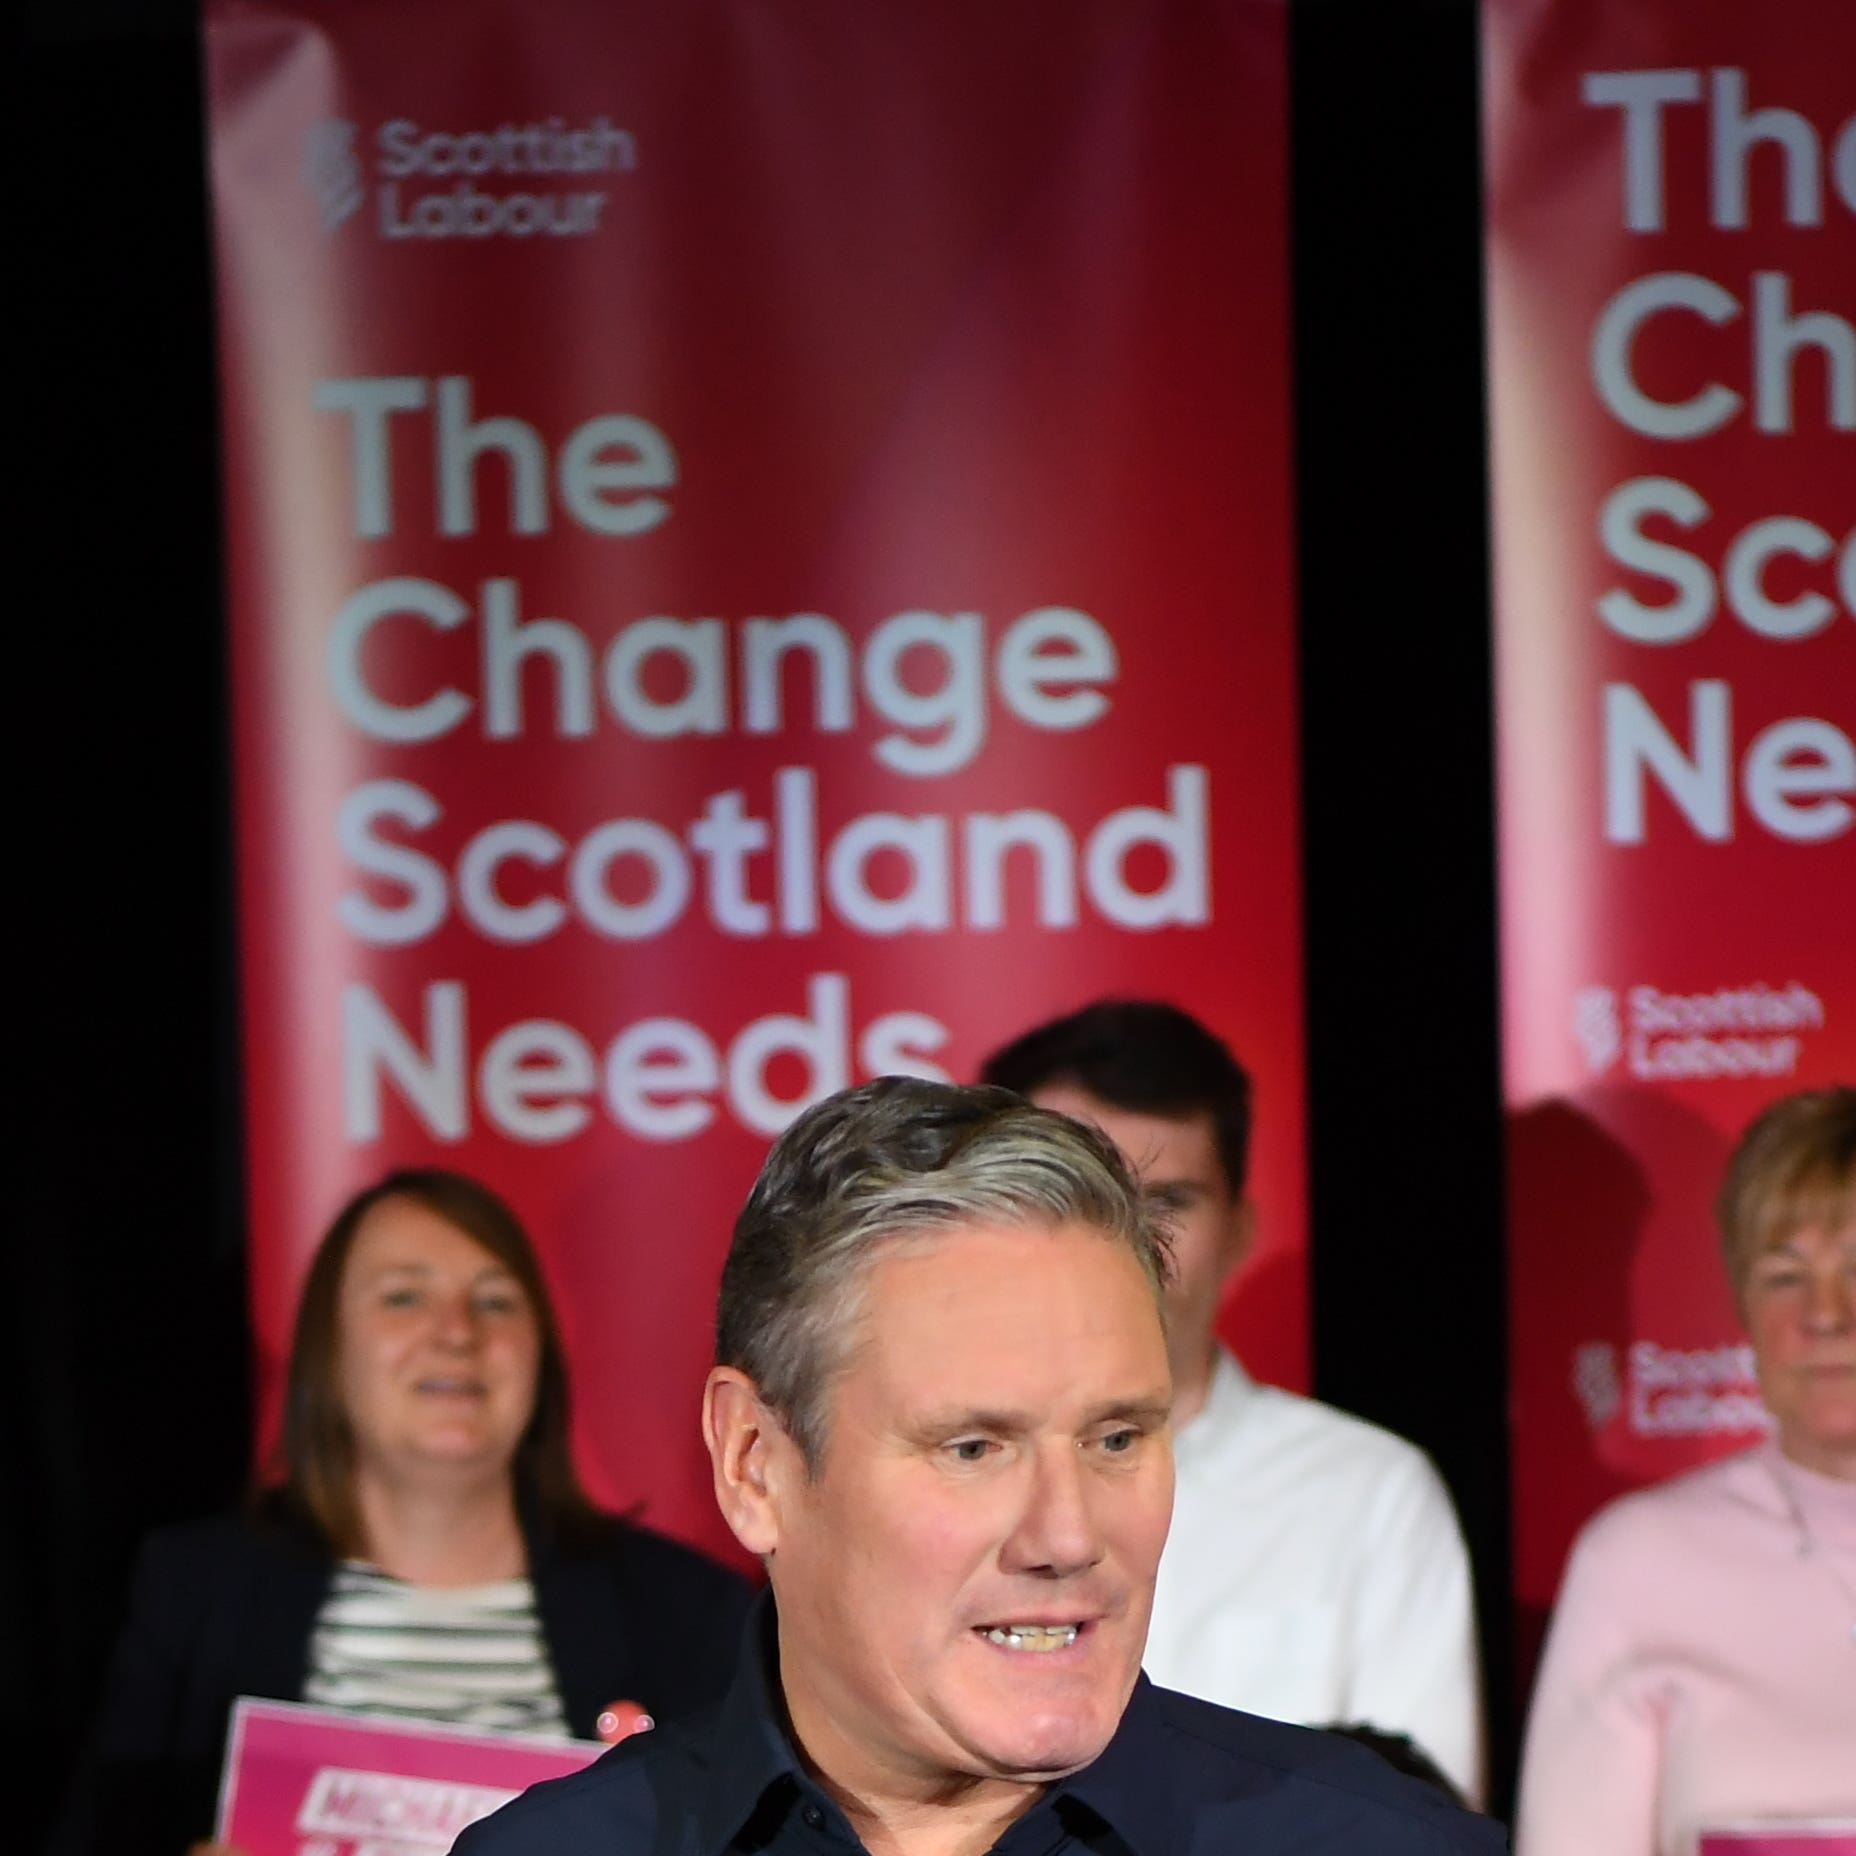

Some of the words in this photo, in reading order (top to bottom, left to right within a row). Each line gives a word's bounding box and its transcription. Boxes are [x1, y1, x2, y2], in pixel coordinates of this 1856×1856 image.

[379, 115, 637, 177] Scottish
[379, 182, 608, 238] Labour
[312, 375, 678, 540] The
[326, 576, 1120, 779] Change
[337, 766, 1212, 945] Scotland
[344, 973, 950, 1144] Needs
[1630, 982, 1824, 1031] Scottish
[1630, 1033, 1801, 1079] Labour
